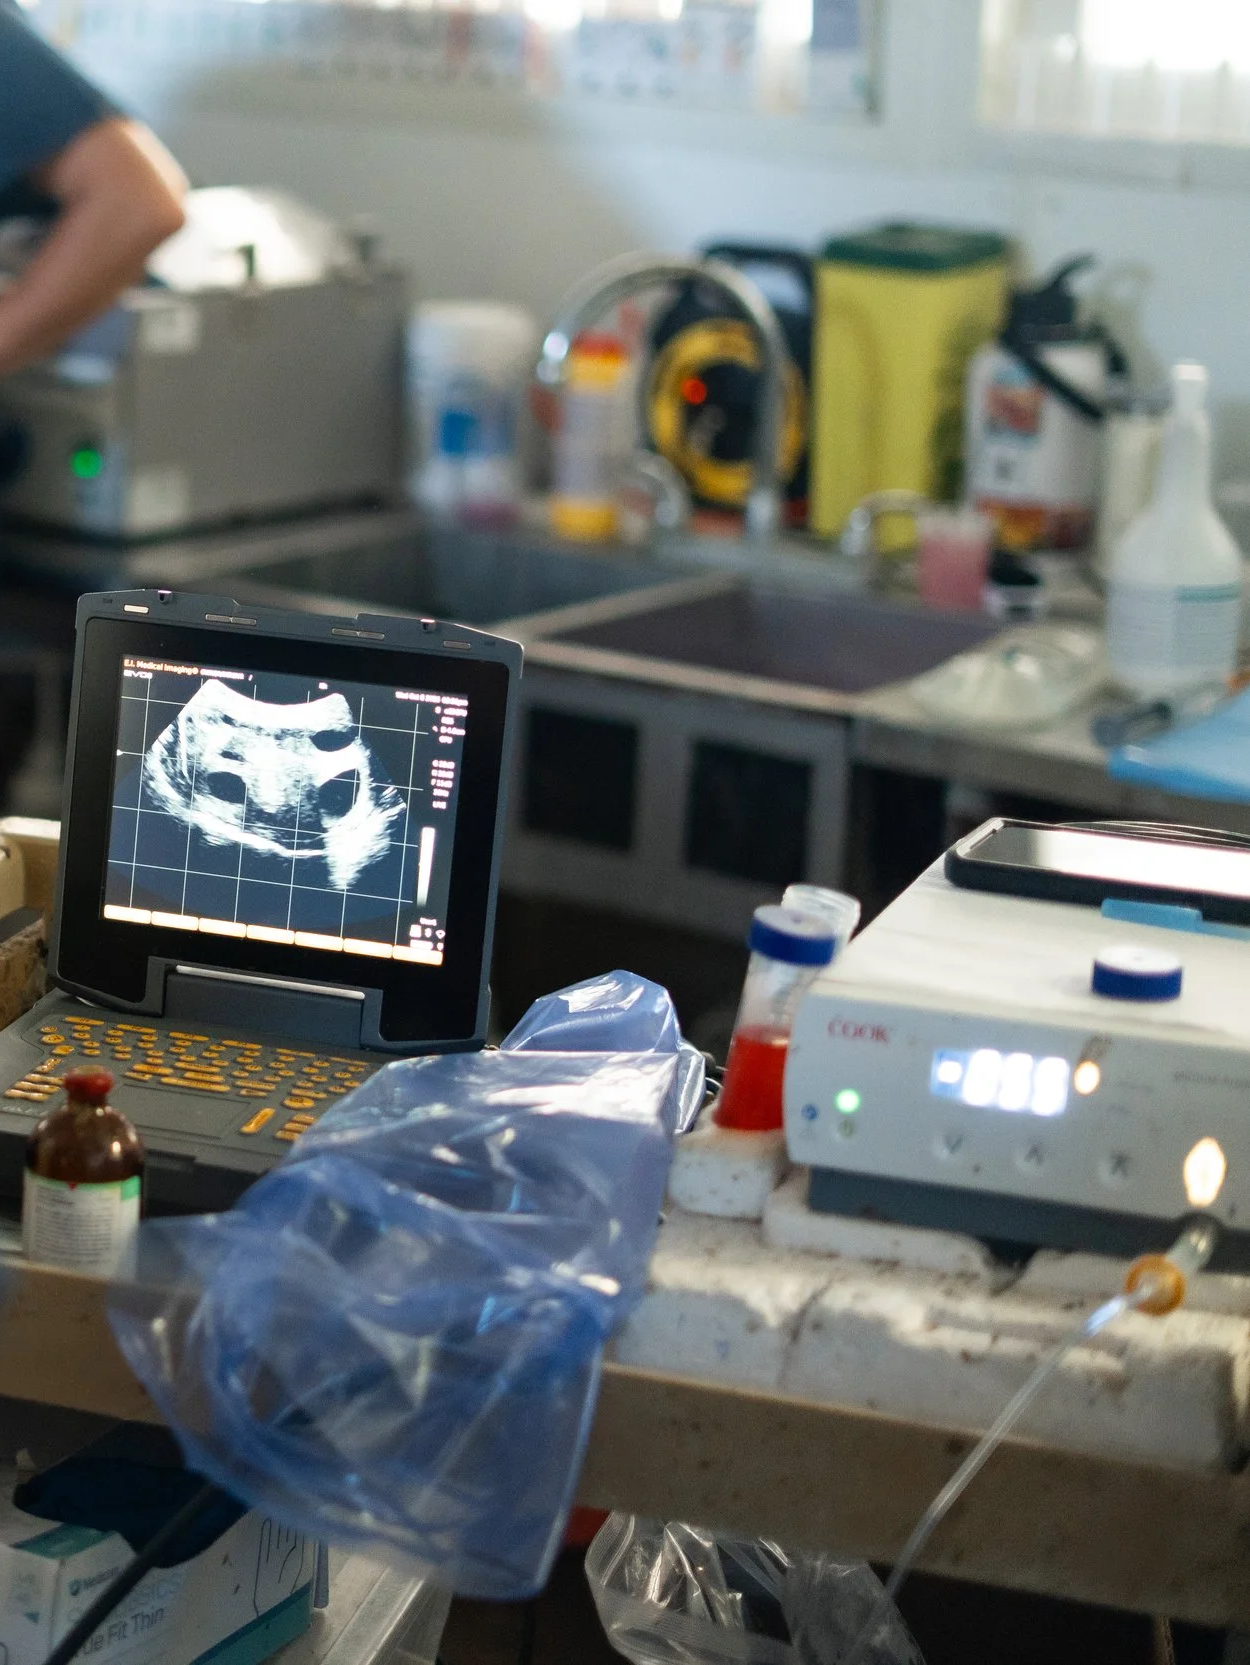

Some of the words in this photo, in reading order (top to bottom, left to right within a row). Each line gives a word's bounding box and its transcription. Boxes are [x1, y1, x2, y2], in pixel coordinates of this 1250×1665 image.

[136, 660, 164, 671] Medical
[827, 1020, 888, 1044] COOK
[106, 1620, 129, 1646] Fit
[130, 1606, 166, 1635] Thin
